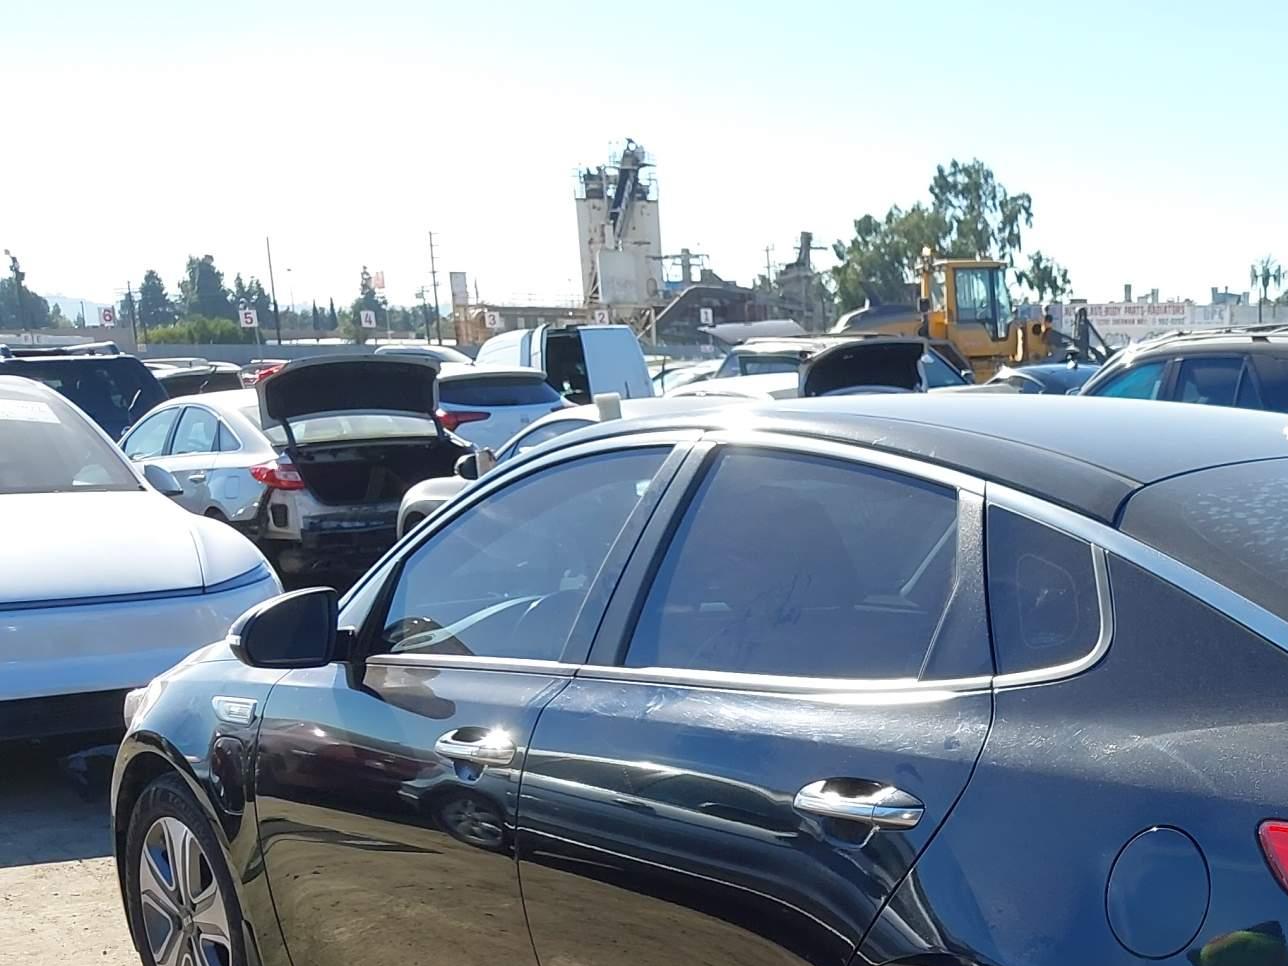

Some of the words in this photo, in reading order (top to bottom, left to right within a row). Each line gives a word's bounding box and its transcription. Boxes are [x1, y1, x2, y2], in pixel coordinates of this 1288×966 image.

[103, 308, 112, 322] 6
[243, 311, 254, 325] 5
[364, 312, 373, 326] 4
[488, 313, 497, 326] 3
